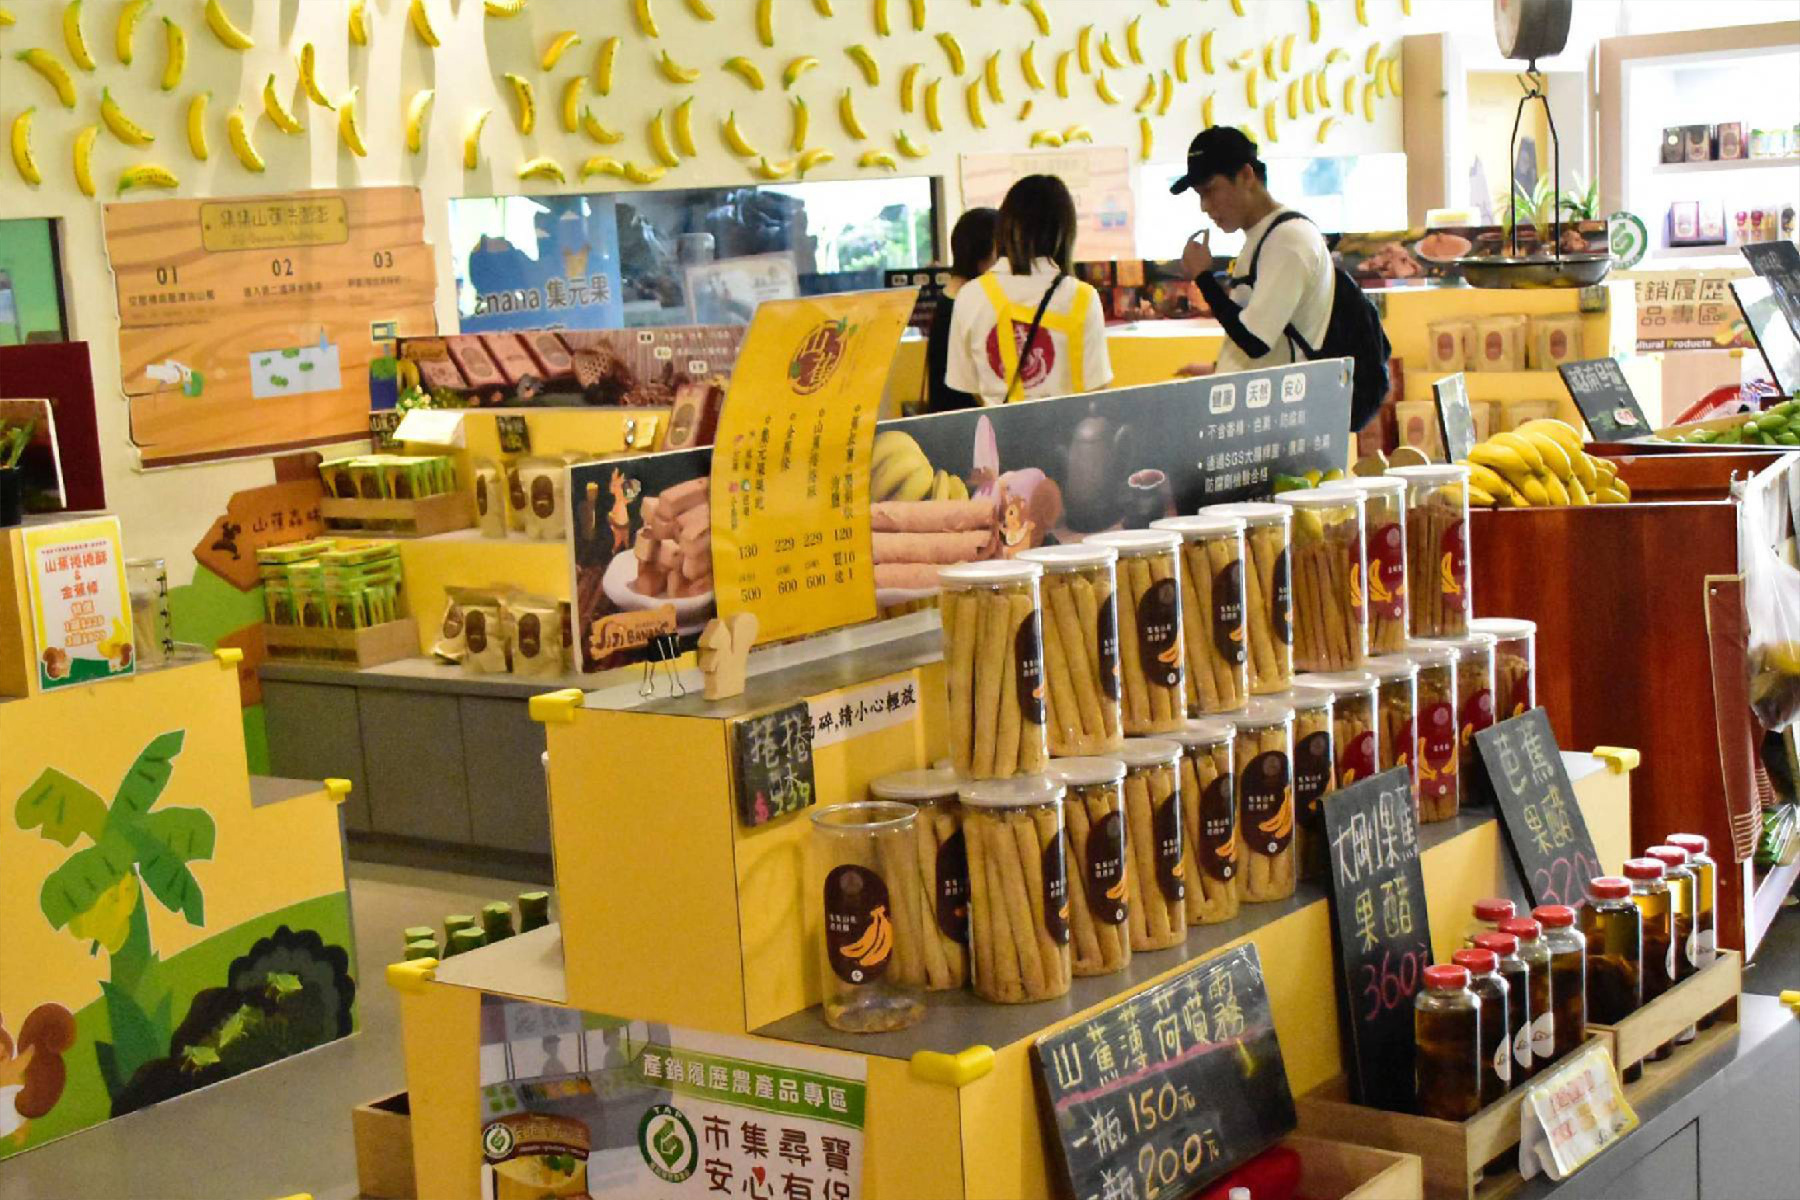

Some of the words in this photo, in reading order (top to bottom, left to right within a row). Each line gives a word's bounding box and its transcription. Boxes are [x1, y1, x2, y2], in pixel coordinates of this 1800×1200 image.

[272, 258, 294, 277] 02
[372, 251, 394, 269] 03
[156, 265, 178, 286] 01
[475, 289, 540, 316] anana
[546, 275, 610, 308] 集元果
[1641, 302, 1724, 325] 品專區
[1666, 339, 1712, 349] Products
[1248, 384, 1269, 403] 天然
[1284, 379, 1304, 398] 安心
[738, 545, 758, 560] 130
[774, 538, 795, 553] 229
[803, 532, 823, 548] 229
[834, 527, 853, 542] 120
[740, 587, 761, 604] 500
[778, 580, 798, 596] 600
[806, 574, 826, 589] 600
[643, 1053, 848, 1114] 產銷履歷農產品專區
[702, 1115, 851, 1176] 市集尋寶
